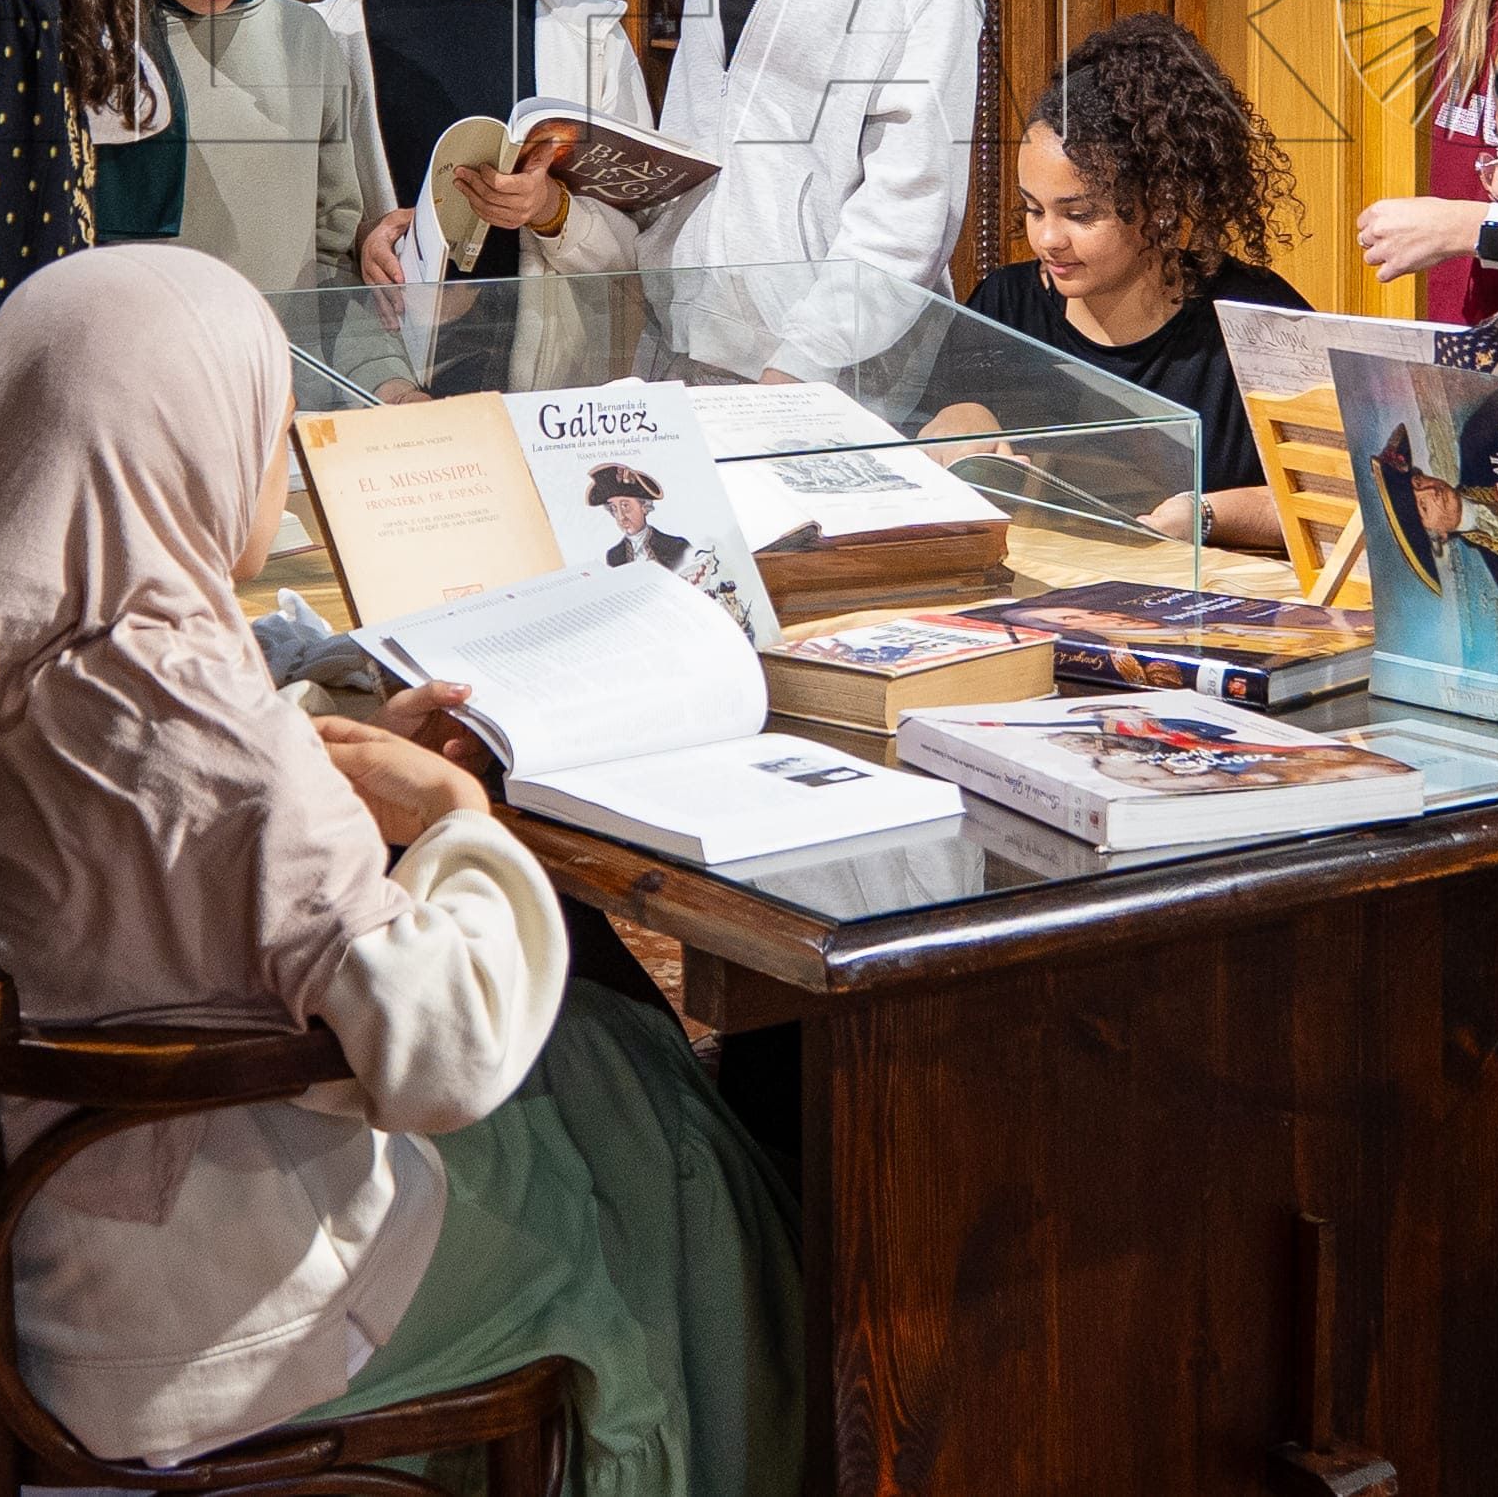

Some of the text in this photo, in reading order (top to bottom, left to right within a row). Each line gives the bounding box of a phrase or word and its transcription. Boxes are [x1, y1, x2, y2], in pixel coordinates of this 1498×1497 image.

[589, 142, 673, 179] BLAS
[539, 402, 658, 439] Gálvez
[597, 400, 647, 412] Bernardo de
[532, 443, 543, 452] La
[544, 441, 576, 452] aventura
[577, 438, 586, 448] de
[358, 462, 488, 493] EL MISSISSIPPI,
[365, 484, 493, 511] FRONTERA DE ESPAÑA
